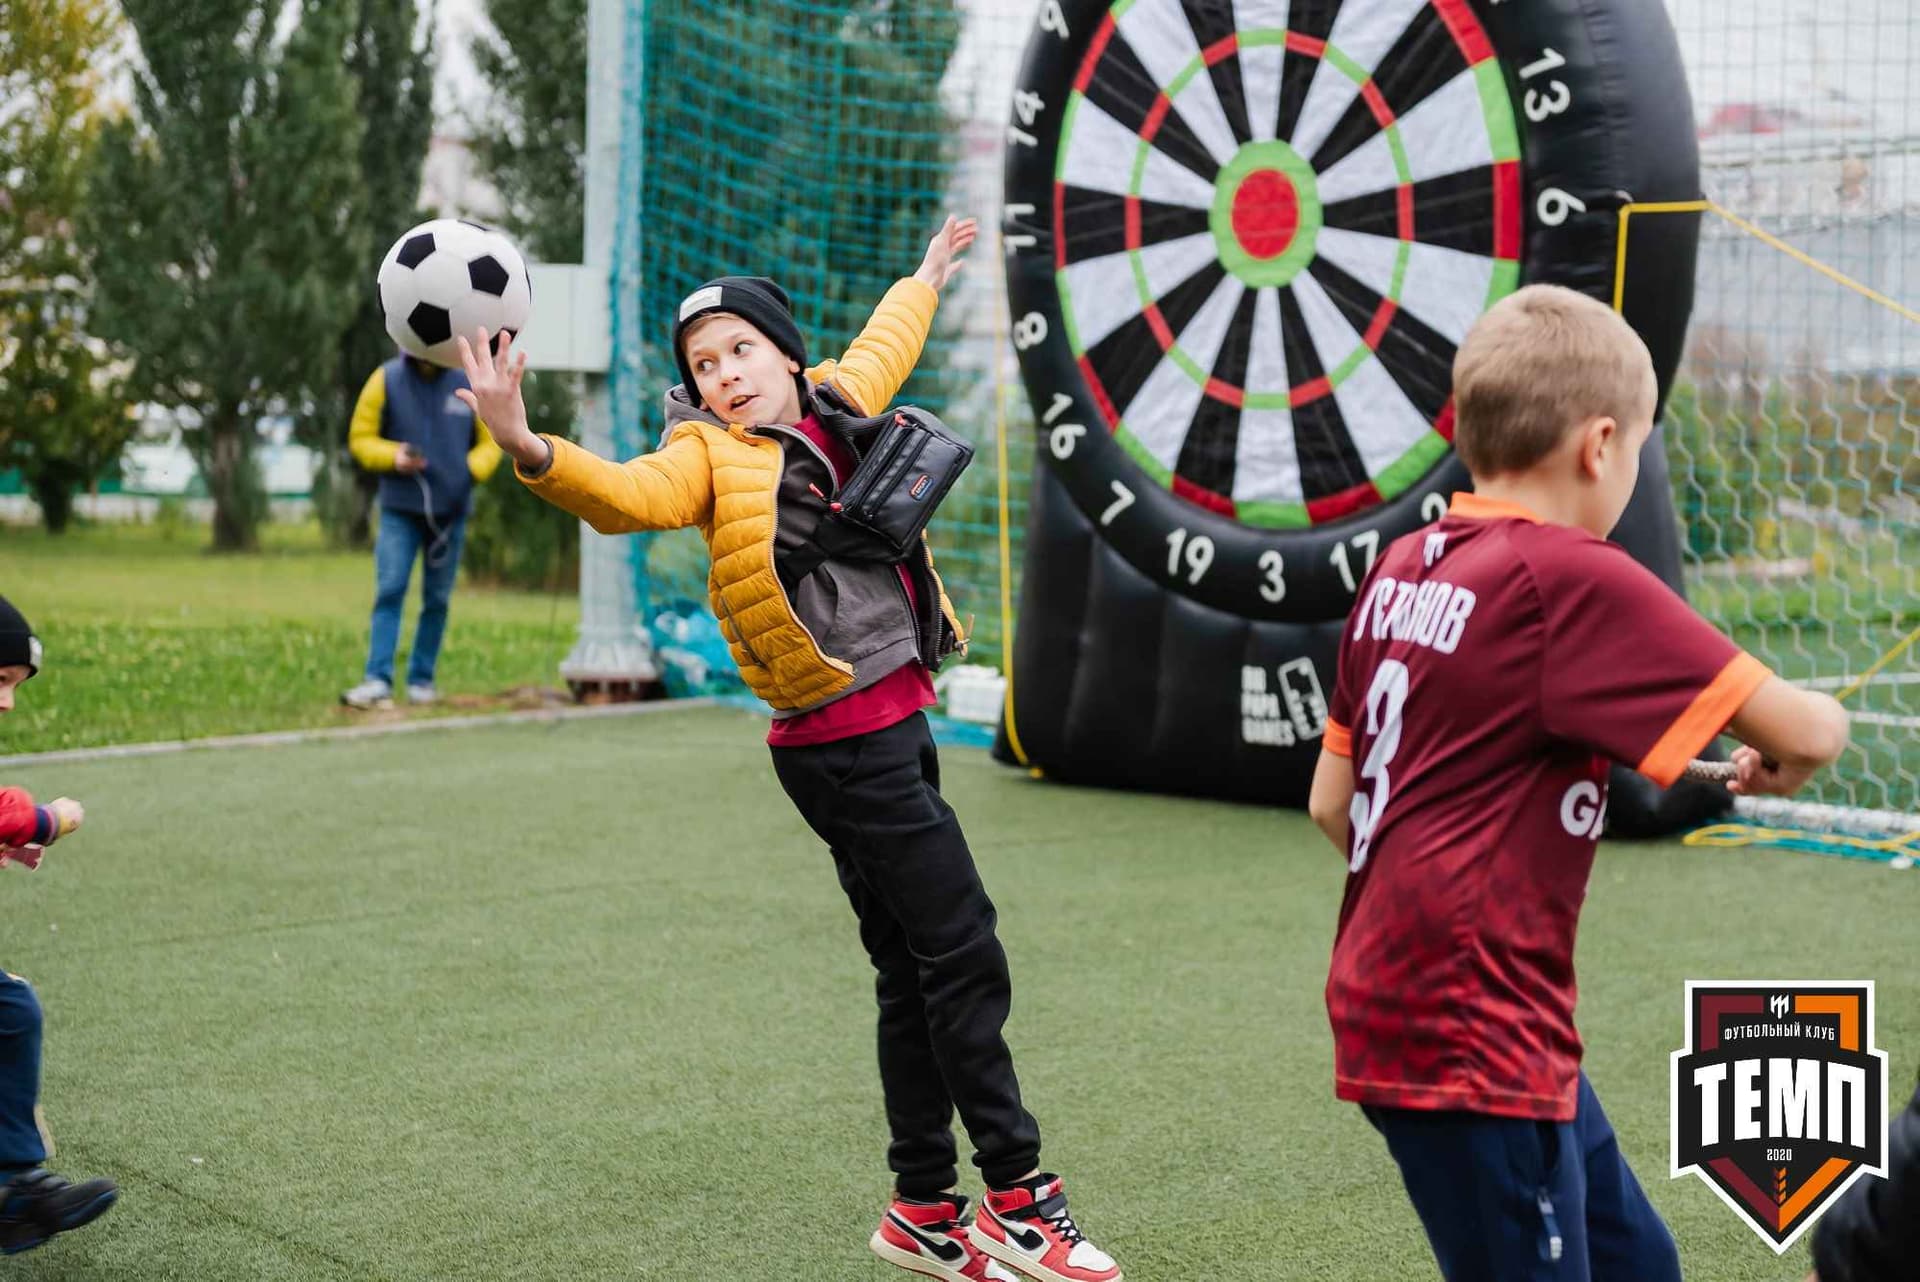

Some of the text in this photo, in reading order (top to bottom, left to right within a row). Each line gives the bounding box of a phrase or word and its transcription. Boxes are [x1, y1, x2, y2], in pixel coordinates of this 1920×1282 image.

[1519, 47, 1571, 122] 13
[1006, 88, 1045, 147] 14
[1003, 203, 1037, 256] 11
[1537, 187, 1586, 226] 6
[1013, 311, 1048, 350] 8
[1042, 392, 1087, 460] 16
[1101, 479, 1135, 526] 7
[1166, 527, 1215, 585] 19
[1258, 550, 1286, 602] 3
[1330, 529, 1380, 592] 17
[1350, 658, 1409, 874] 3
